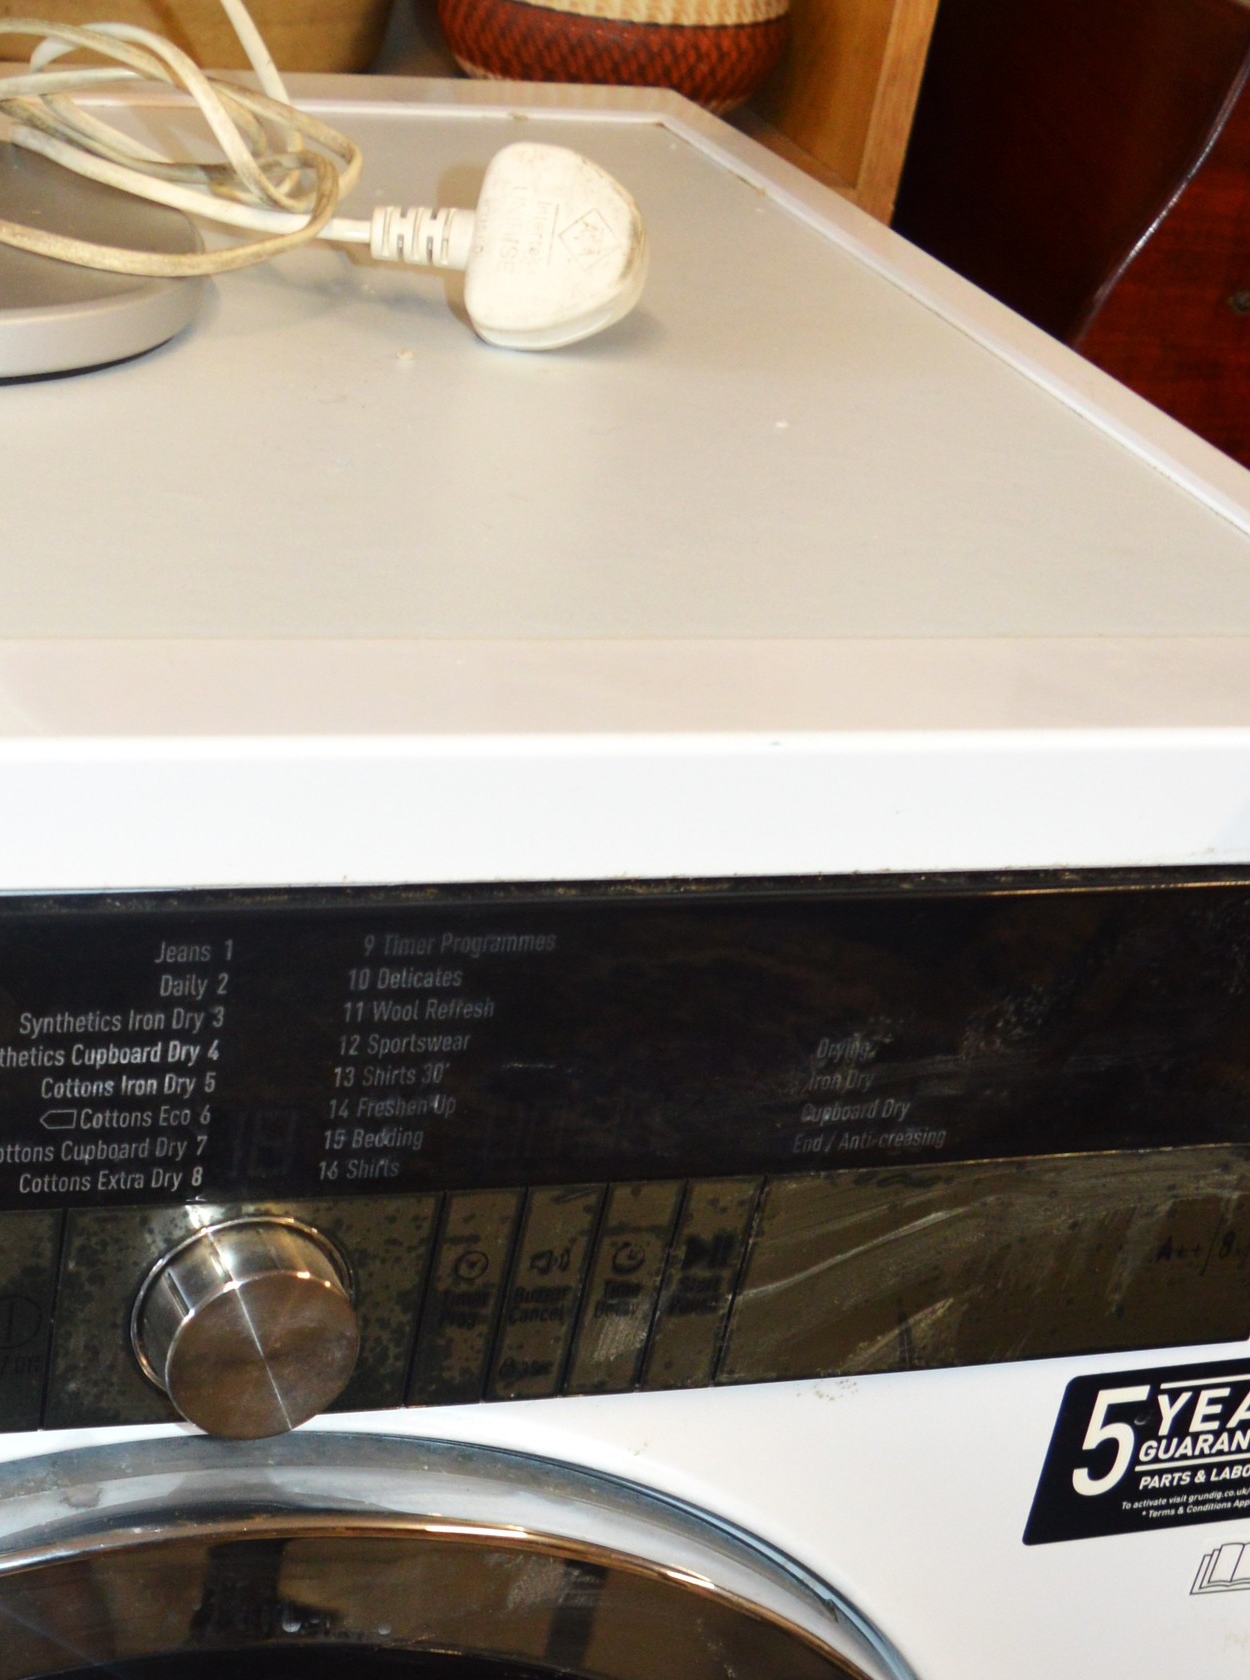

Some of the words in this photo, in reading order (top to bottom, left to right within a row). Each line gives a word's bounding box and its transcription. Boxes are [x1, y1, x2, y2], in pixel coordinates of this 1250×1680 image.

[155, 941, 211, 963] Jeans
[224, 939, 233, 961] 1
[364, 934, 375, 956] 9
[383, 934, 435, 956] Timer
[440, 932, 557, 960] Programmes
[160, 974, 208, 1001] Daily
[217, 973, 229, 995] 2
[349, 967, 370, 991] 10
[377, 966, 463, 989] Delicates
[19, 1011, 122, 1039] Synthetics
[128, 1009, 165, 1031] Iron
[172, 1008, 205, 1034] Dry
[212, 1006, 225, 1029] 3
[344, 1001, 365, 1024] 11
[372, 1000, 419, 1022] Wool
[425, 998, 495, 1021] Refresh
[71, 1042, 162, 1070] Cupboard
[167, 1040, 200, 1066] Dry
[207, 1040, 220, 1061] 4
[339, 1034, 361, 1056] 12
[367, 1033, 471, 1058] Sportswear
[817, 1036, 876, 1063] Drying
[41, 1077, 114, 1099] Cottons
[121, 1074, 158, 1096] Iron
[163, 1073, 196, 1099] Dry
[204, 1071, 217, 1093] 5
[334, 1066, 355, 1088] 13
[362, 1065, 417, 1087] Shirts
[80, 1108, 152, 1129] Cottons
[159, 1105, 191, 1127] Eco
[200, 1104, 211, 1125] 6
[329, 1098, 350, 1119] 14
[357, 1096, 427, 1118] Freshen
[801, 1099, 880, 1127] Cupboard
[881, 1098, 911, 1122] Dry
[61, 1139, 149, 1166] Cupboard
[155, 1136, 188, 1162] Dry
[196, 1135, 208, 1156] 7
[324, 1128, 345, 1150] 15
[352, 1127, 424, 1150] Bedding
[793, 1133, 823, 1154] End
[19, 1172, 91, 1194] Cottons
[97, 1170, 145, 1191] Extra
[151, 1167, 183, 1192] Dry
[191, 1166, 203, 1187] 8
[318, 1160, 338, 1181] 16
[346, 1157, 400, 1180] Shirts
[1072, 1384, 1151, 1497] 5
[1139, 1471, 1191, 1490] PARTS
[1194, 1470, 1206, 1483] &
[1121, 1501, 1131, 1511] To
[1133, 1497, 1168, 1509] activate
[1169, 1495, 1187, 1504] visit
[1149, 1507, 1175, 1518] Terms
[1177, 1506, 1184, 1515] &
[1186, 1500, 1231, 1514] Conditions
